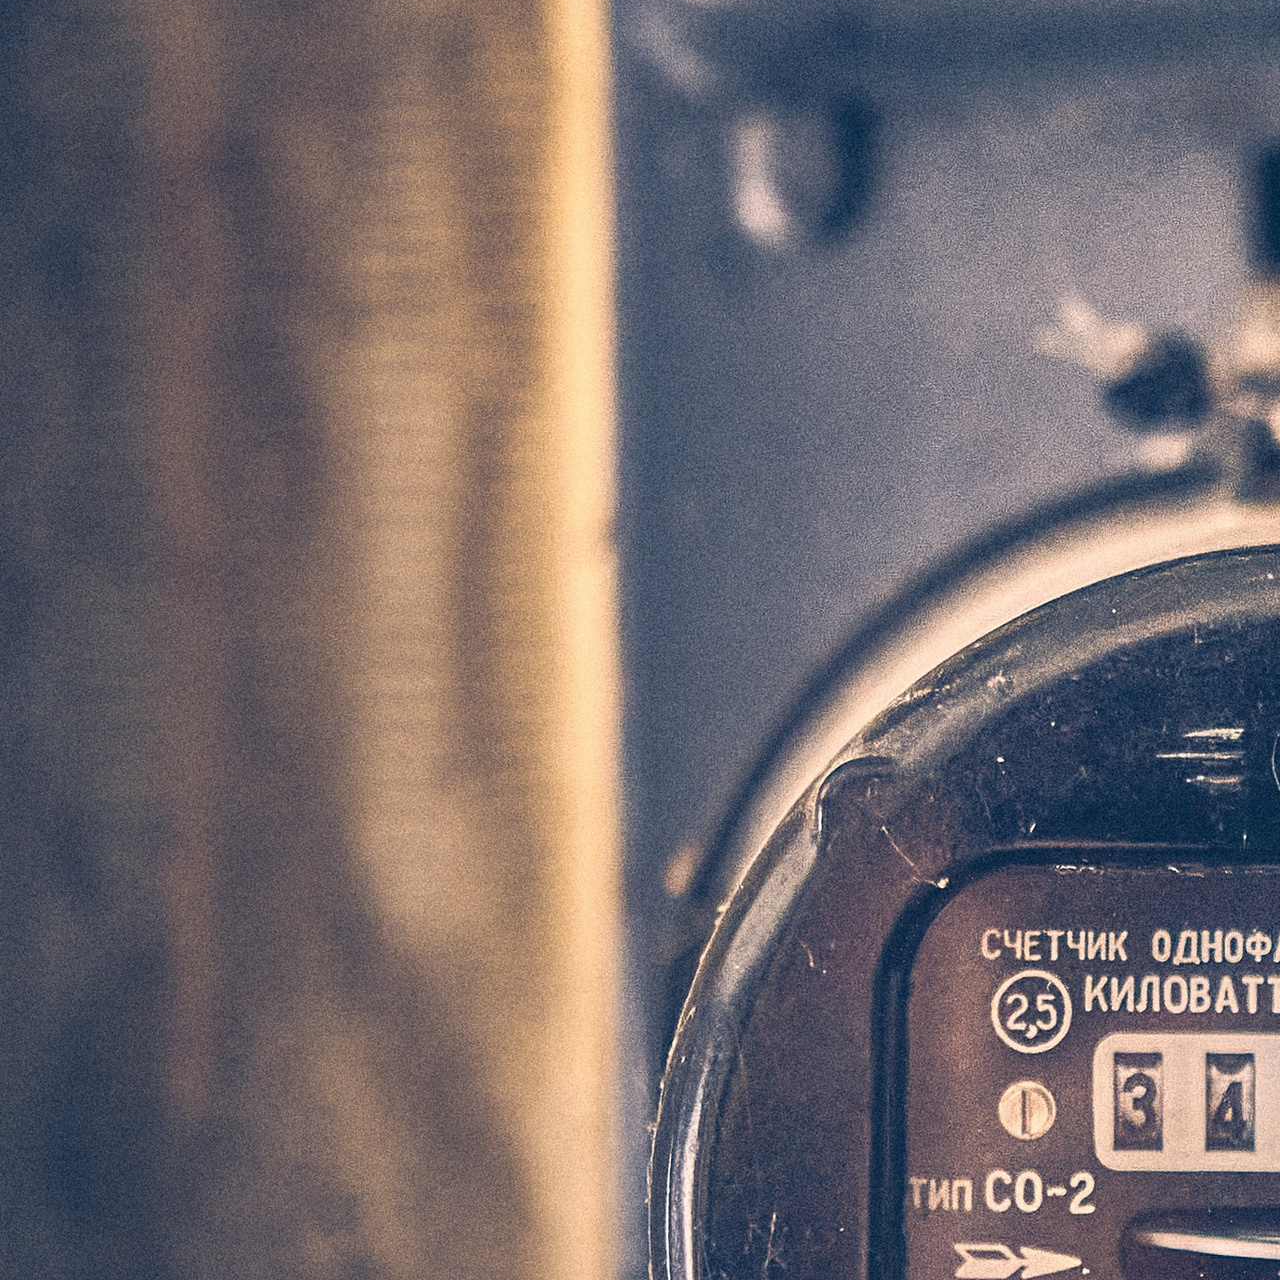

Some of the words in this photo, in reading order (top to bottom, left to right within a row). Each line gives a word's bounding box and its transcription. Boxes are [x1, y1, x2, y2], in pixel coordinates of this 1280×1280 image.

[981, 929, 1128, 961] СЧЕТЧИК
[1004, 994, 1058, 1038] 2,5
[985, 1170, 1096, 1214] СО-2
